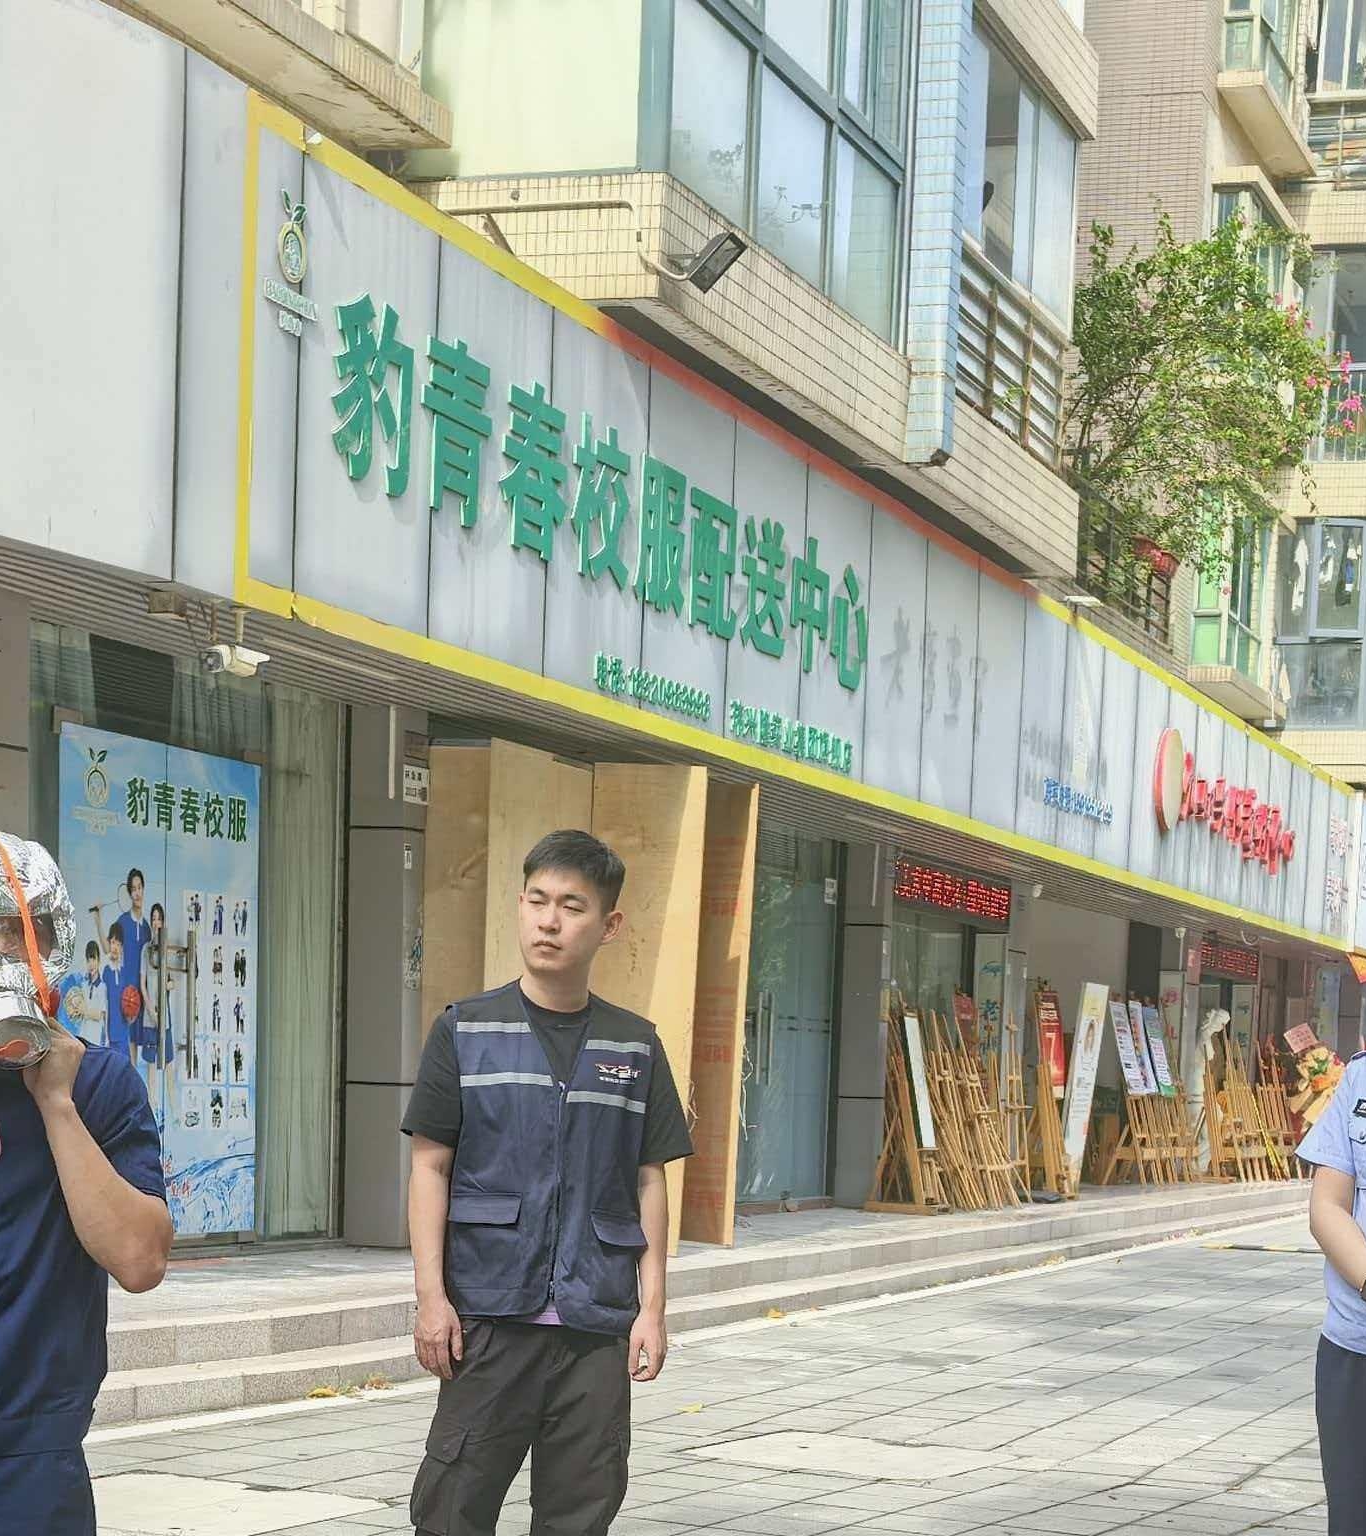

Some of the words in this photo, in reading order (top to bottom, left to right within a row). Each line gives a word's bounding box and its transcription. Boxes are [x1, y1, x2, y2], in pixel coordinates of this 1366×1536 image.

[332, 292, 868, 690] 豹青春校服配送中心
[125, 776, 248, 843] 豹青春校服
